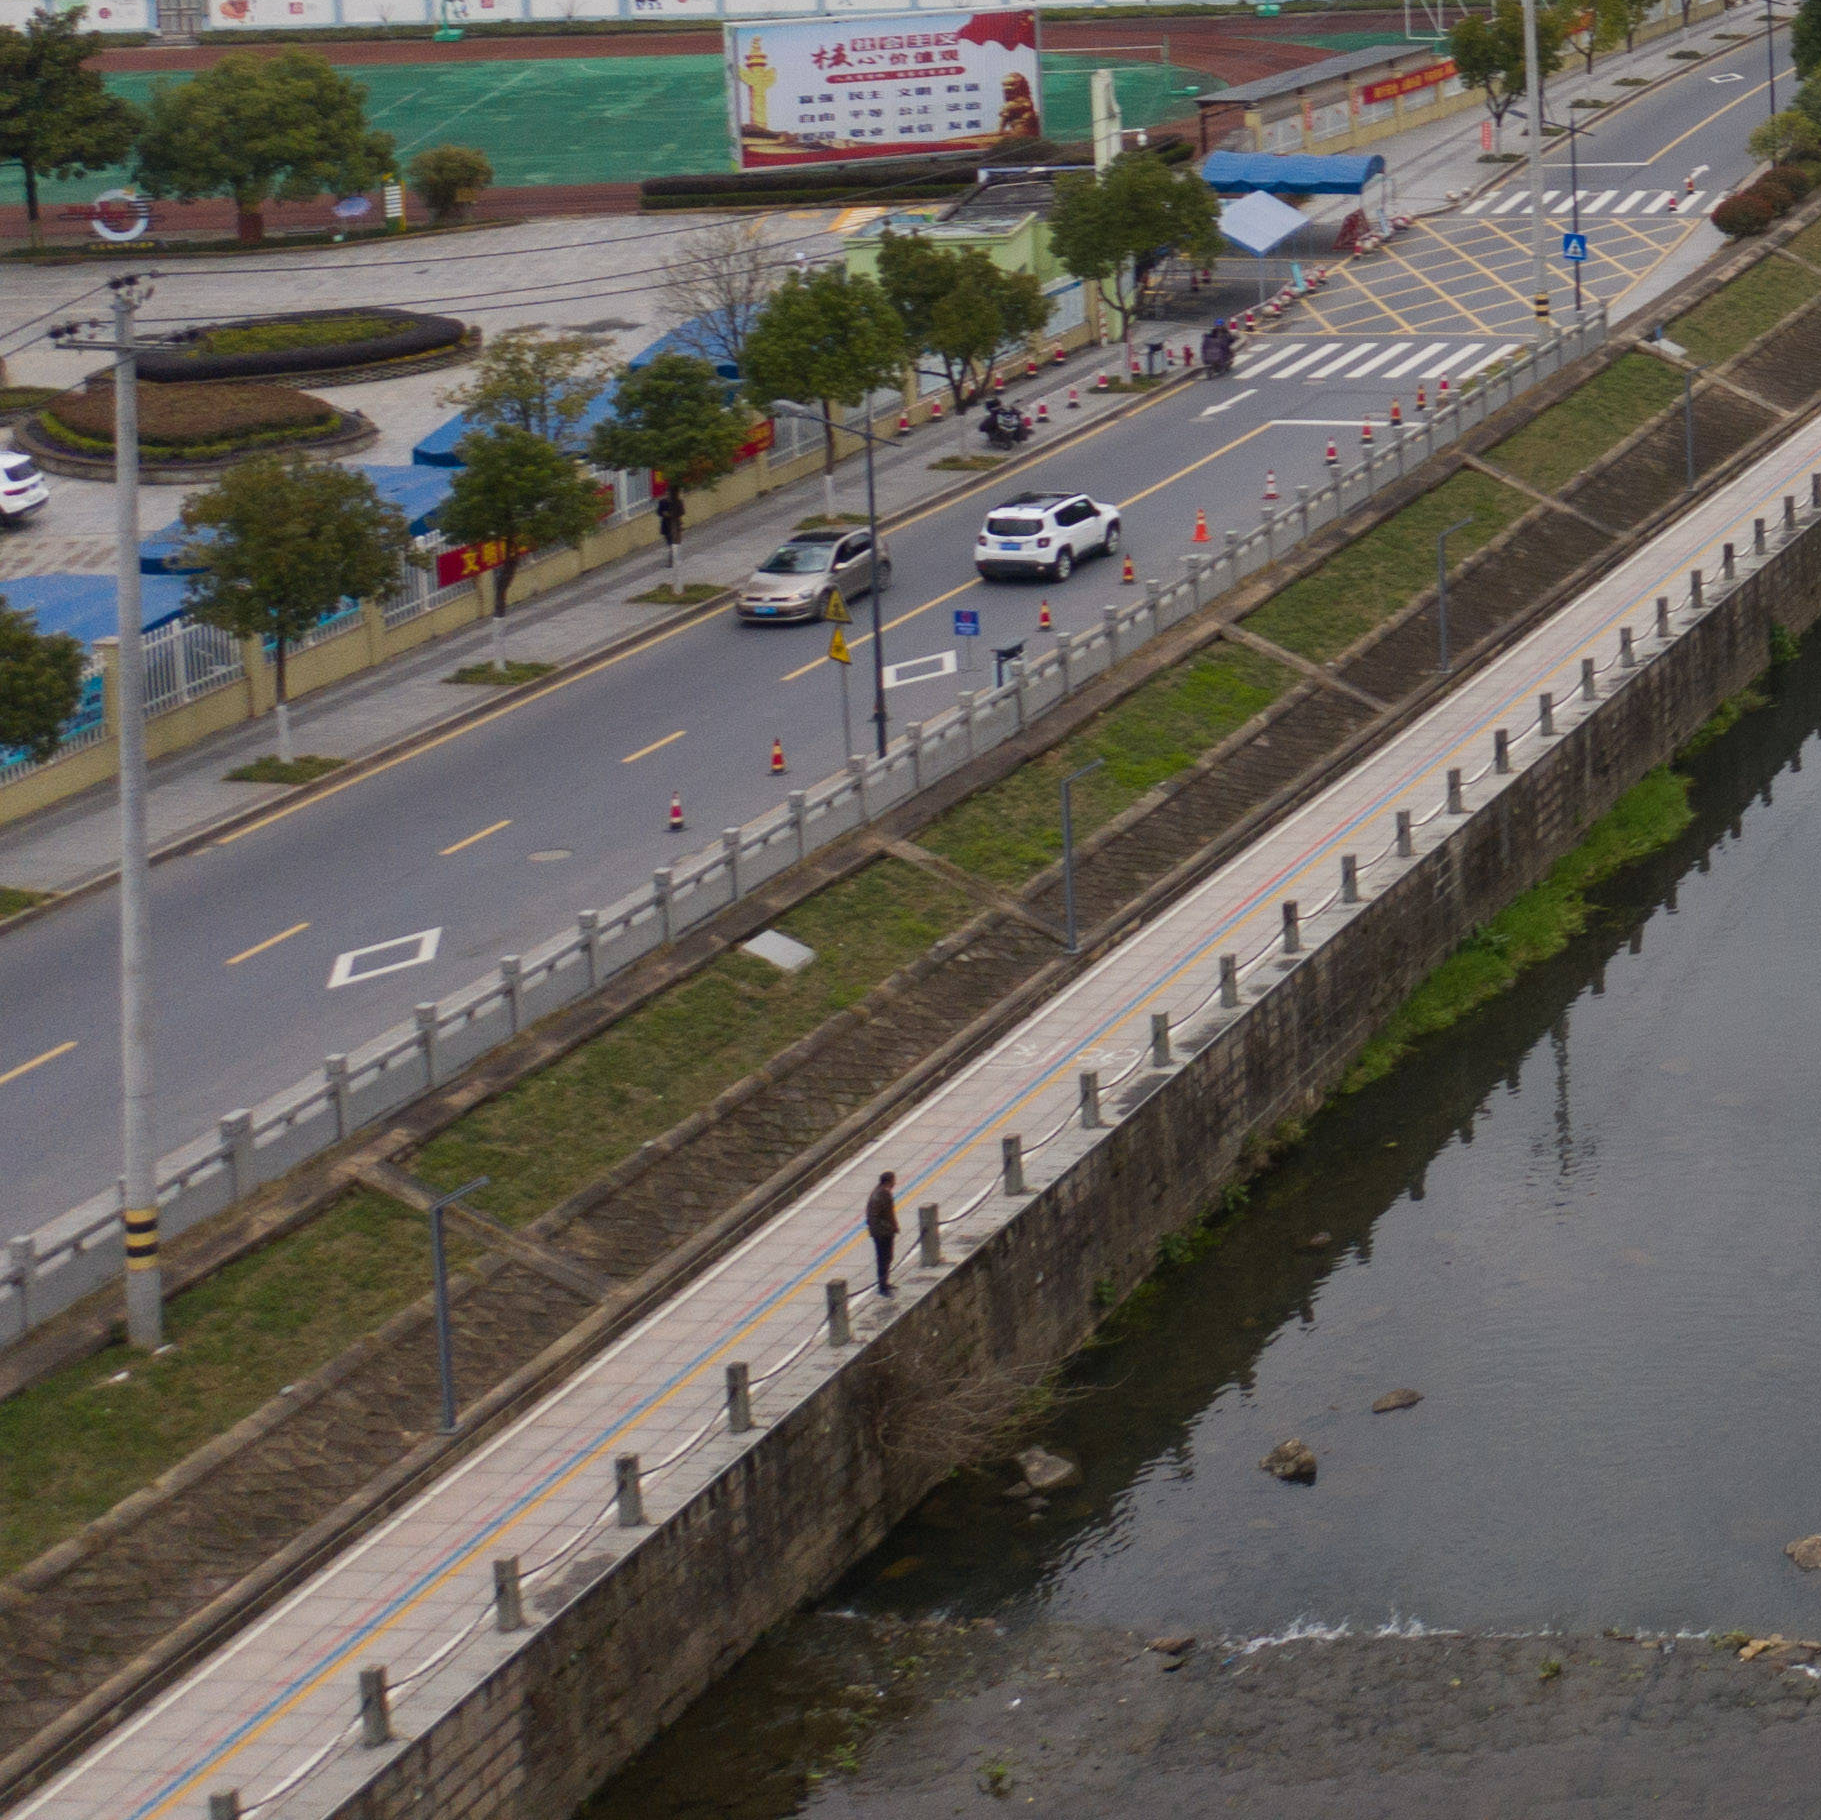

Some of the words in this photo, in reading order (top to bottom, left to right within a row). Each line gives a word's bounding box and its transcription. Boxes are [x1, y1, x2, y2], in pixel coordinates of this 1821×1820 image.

[851, 32, 960, 52] 社会主义
[811, 43, 959, 70] 核心价值观
[848, 90, 883, 100] 民主
[898, 86, 932, 97] 文明
[799, 112, 835, 123] 自由
[850, 109, 883, 119] 平等
[898, 105, 931, 115] 公正
[850, 127, 884, 138] 敬业
